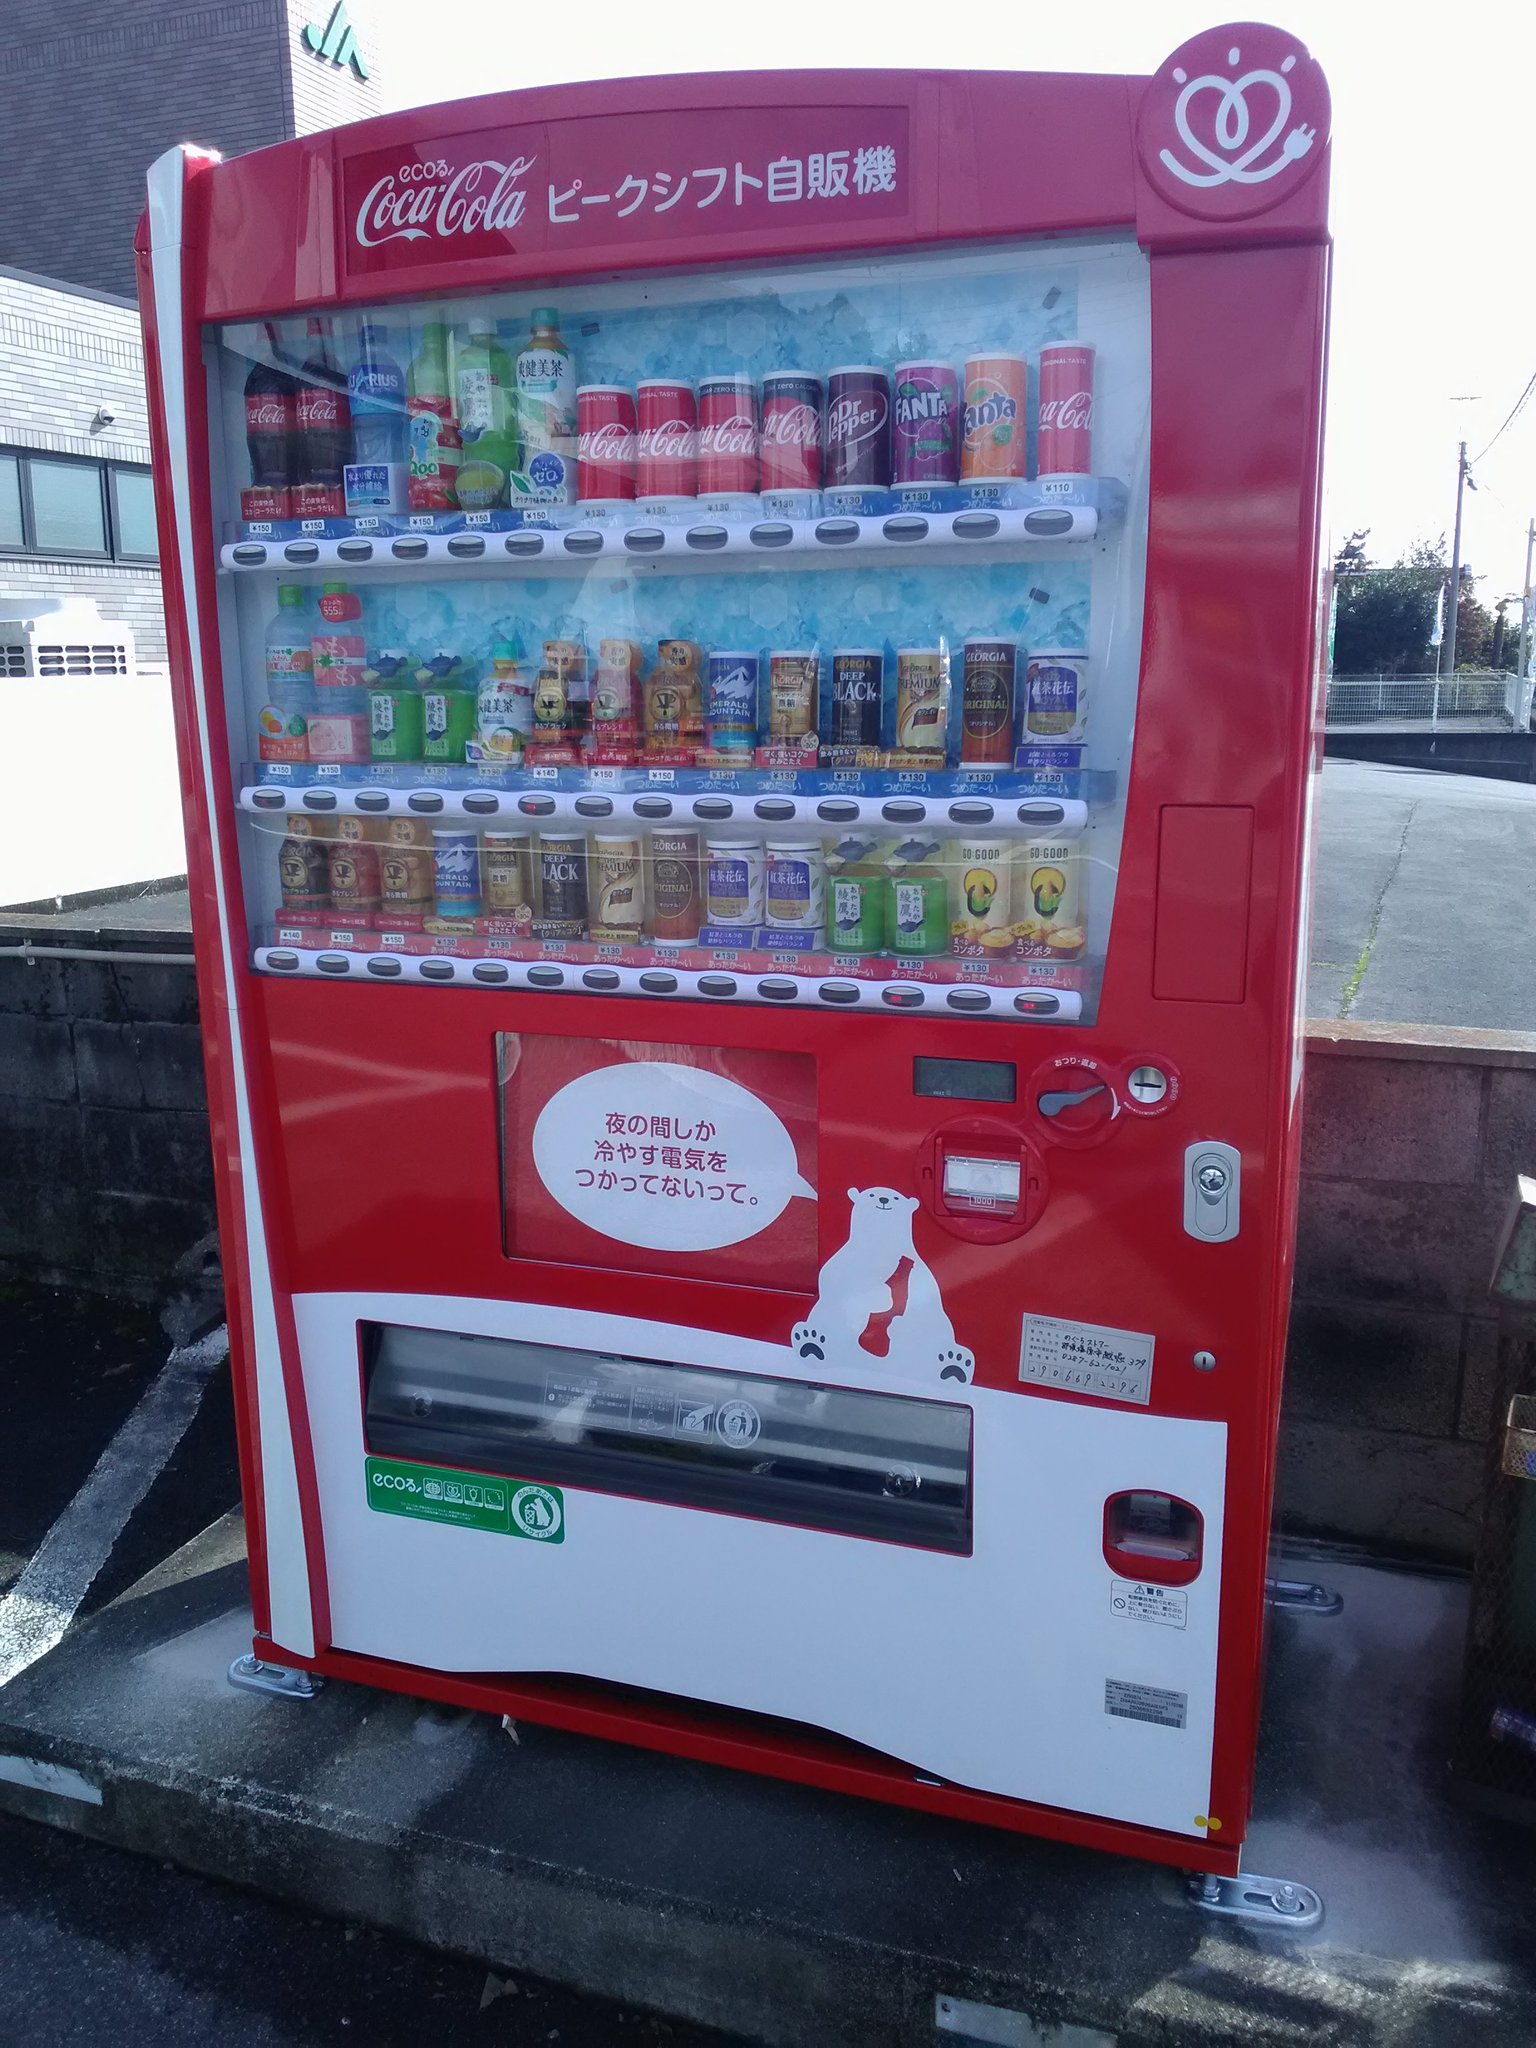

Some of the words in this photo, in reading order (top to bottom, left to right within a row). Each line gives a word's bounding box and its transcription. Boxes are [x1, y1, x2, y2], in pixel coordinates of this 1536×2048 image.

[548, 145, 896, 223] ピークシフト自販機
[356, 154, 537, 247] Coca-Cola
[838, 400, 862, 422] Dr
[896, 392, 947, 425] FANTA
[828, 408, 877, 445] Pepper
[974, 488, 998, 497] ¥130
[1046, 483, 1069, 492] ¥110
[905, 492, 928, 501] ¥130
[526, 512, 546, 520] ¥150
[412, 518, 431, 526] ¥150
[840, 672, 865, 680] DEEP
[542, 863, 578, 880] LACK
[710, 870, 745, 882] 紅茶花伝
[770, 871, 806, 884] 紅茶花伝
[954, 937, 968, 945] 食べる
[1017, 938, 1035, 946] 食べる
[953, 945, 984, 956] コンポタ
[1017, 946, 1052, 957] コンポタ
[605, 1112, 716, 1141] 夜の間しか
[593, 1140, 727, 1173] 冷やす電気を
[575, 1168, 758, 1206] つかってないって。
[973, 1197, 992, 1206] 1000
[523, 1524, 553, 1538] リサイクル
[1147, 1587, 1163, 1597] 警告
